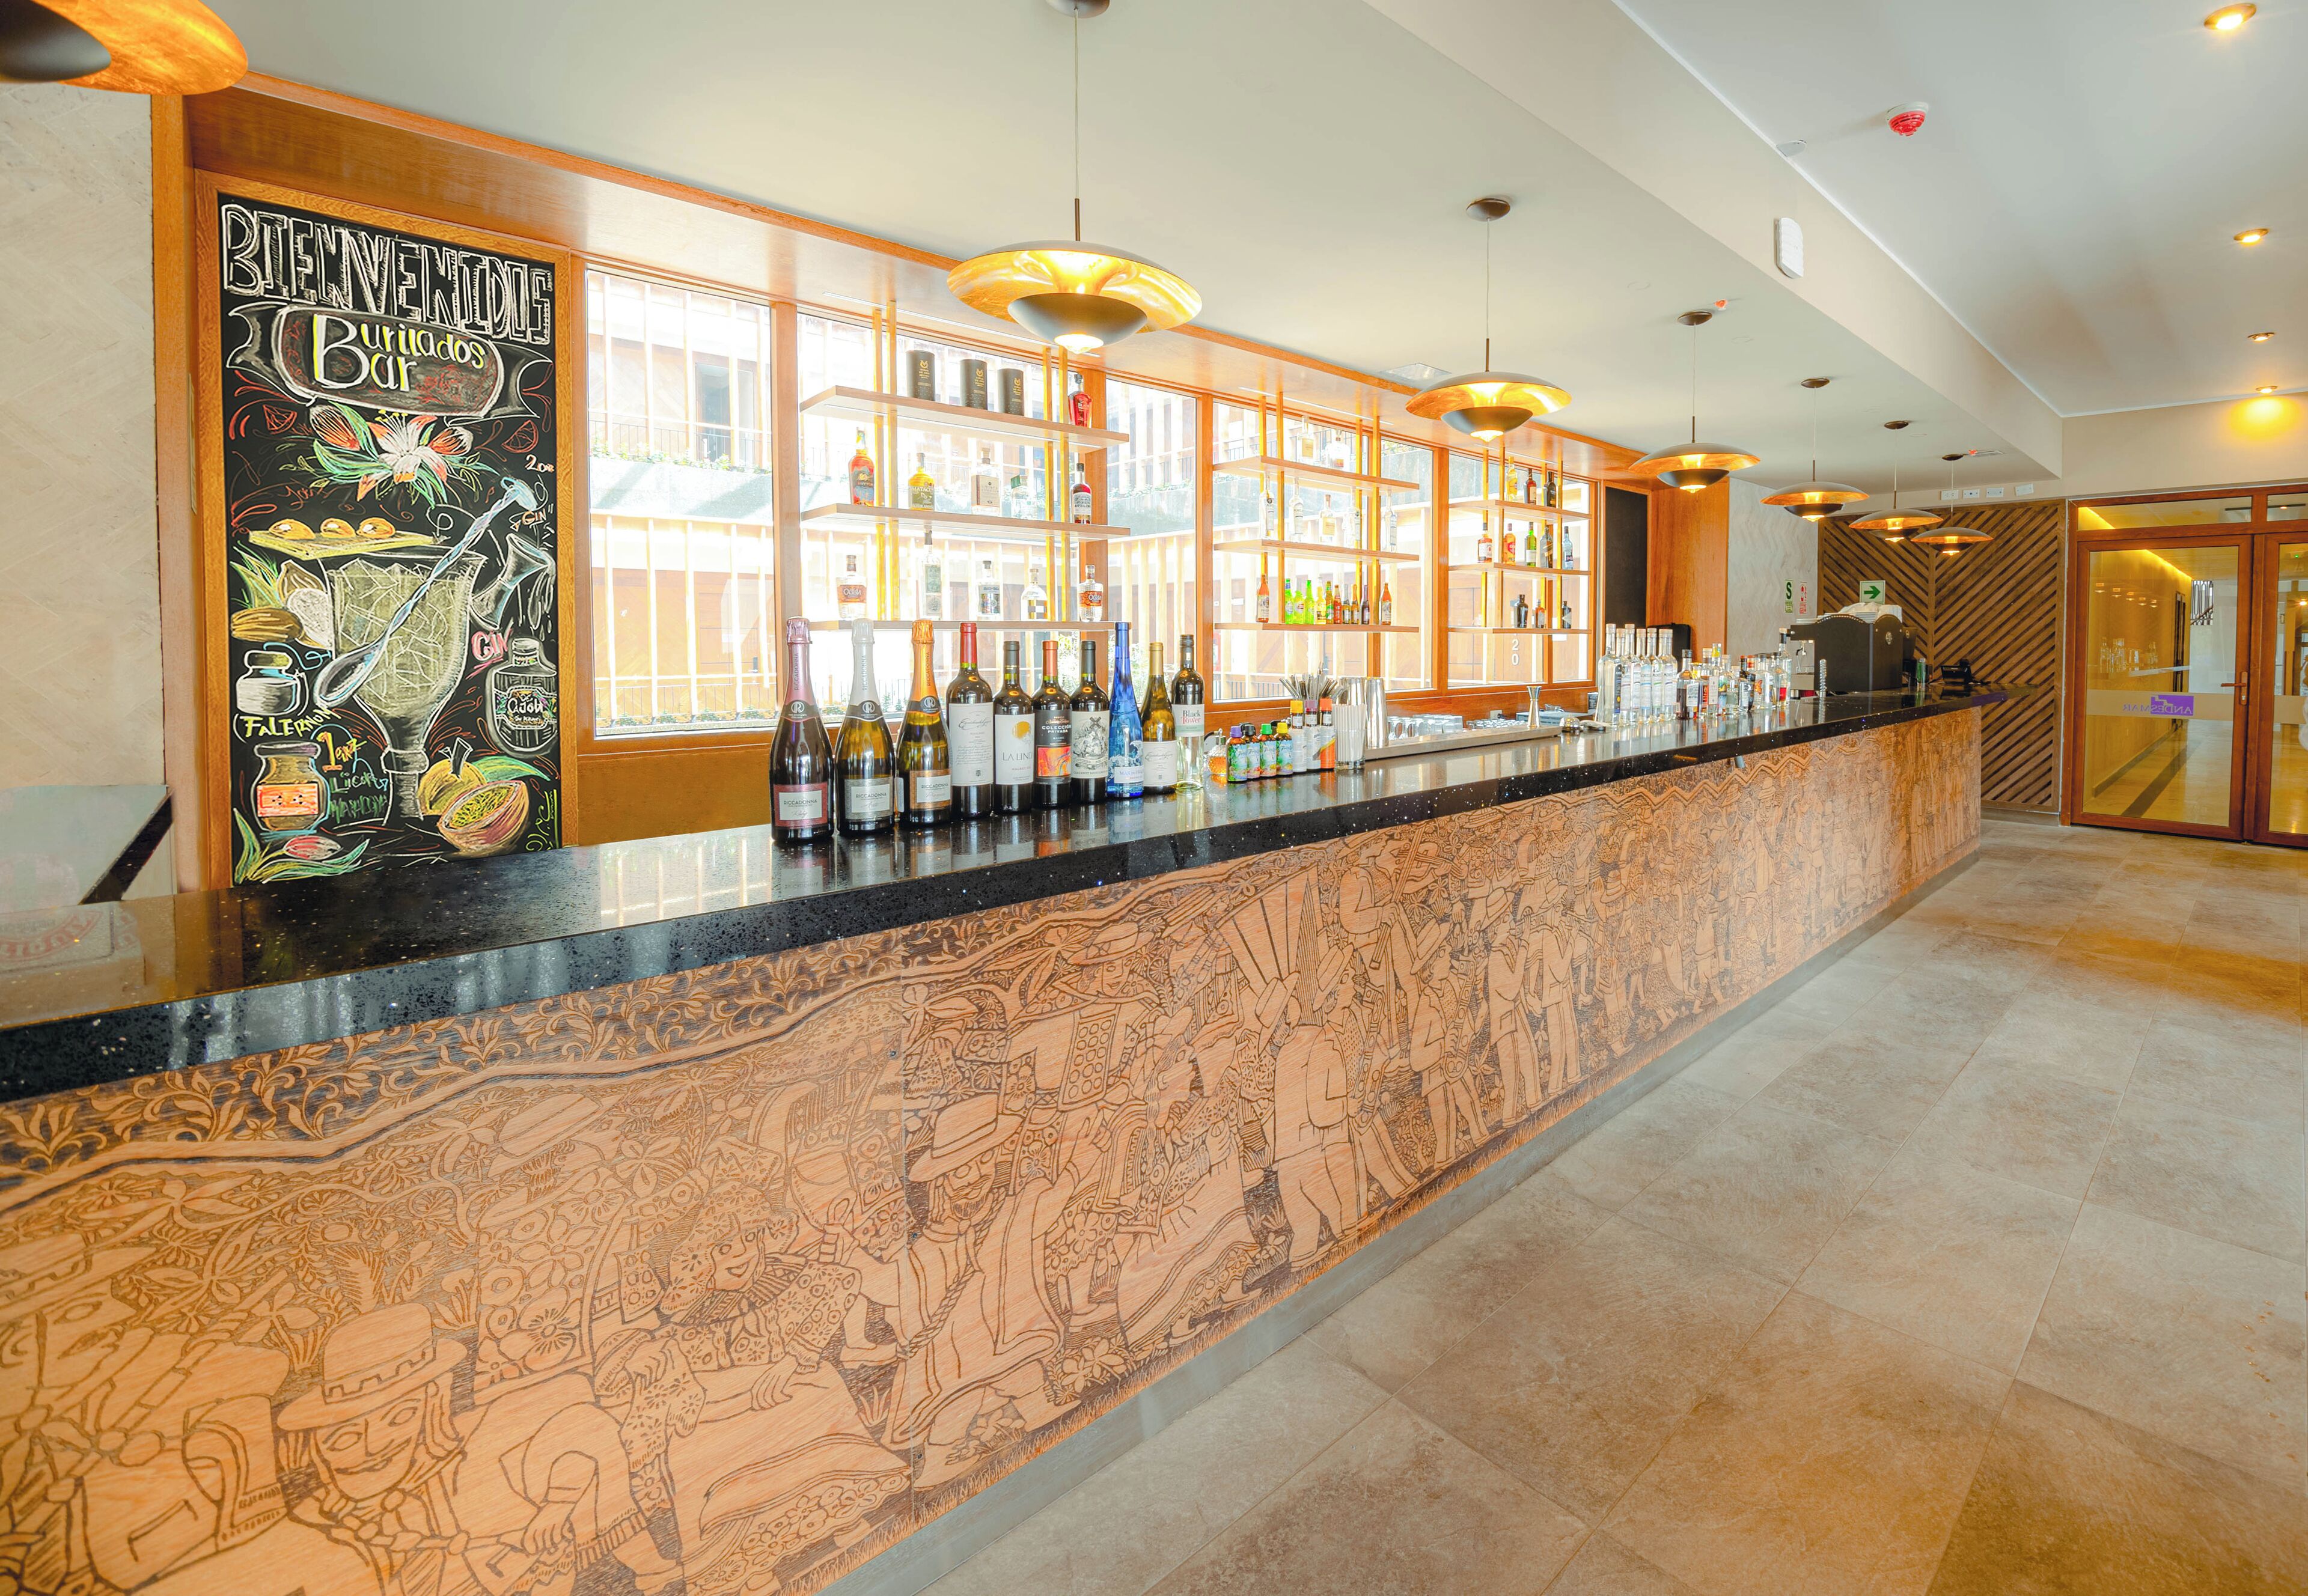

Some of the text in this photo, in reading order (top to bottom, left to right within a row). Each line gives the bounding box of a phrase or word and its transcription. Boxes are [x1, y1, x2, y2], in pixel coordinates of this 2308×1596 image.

[221, 204, 553, 345] BIENVENIDOS
[1786, 582, 1792, 600] S
[1003, 752, 1015, 761] LA
